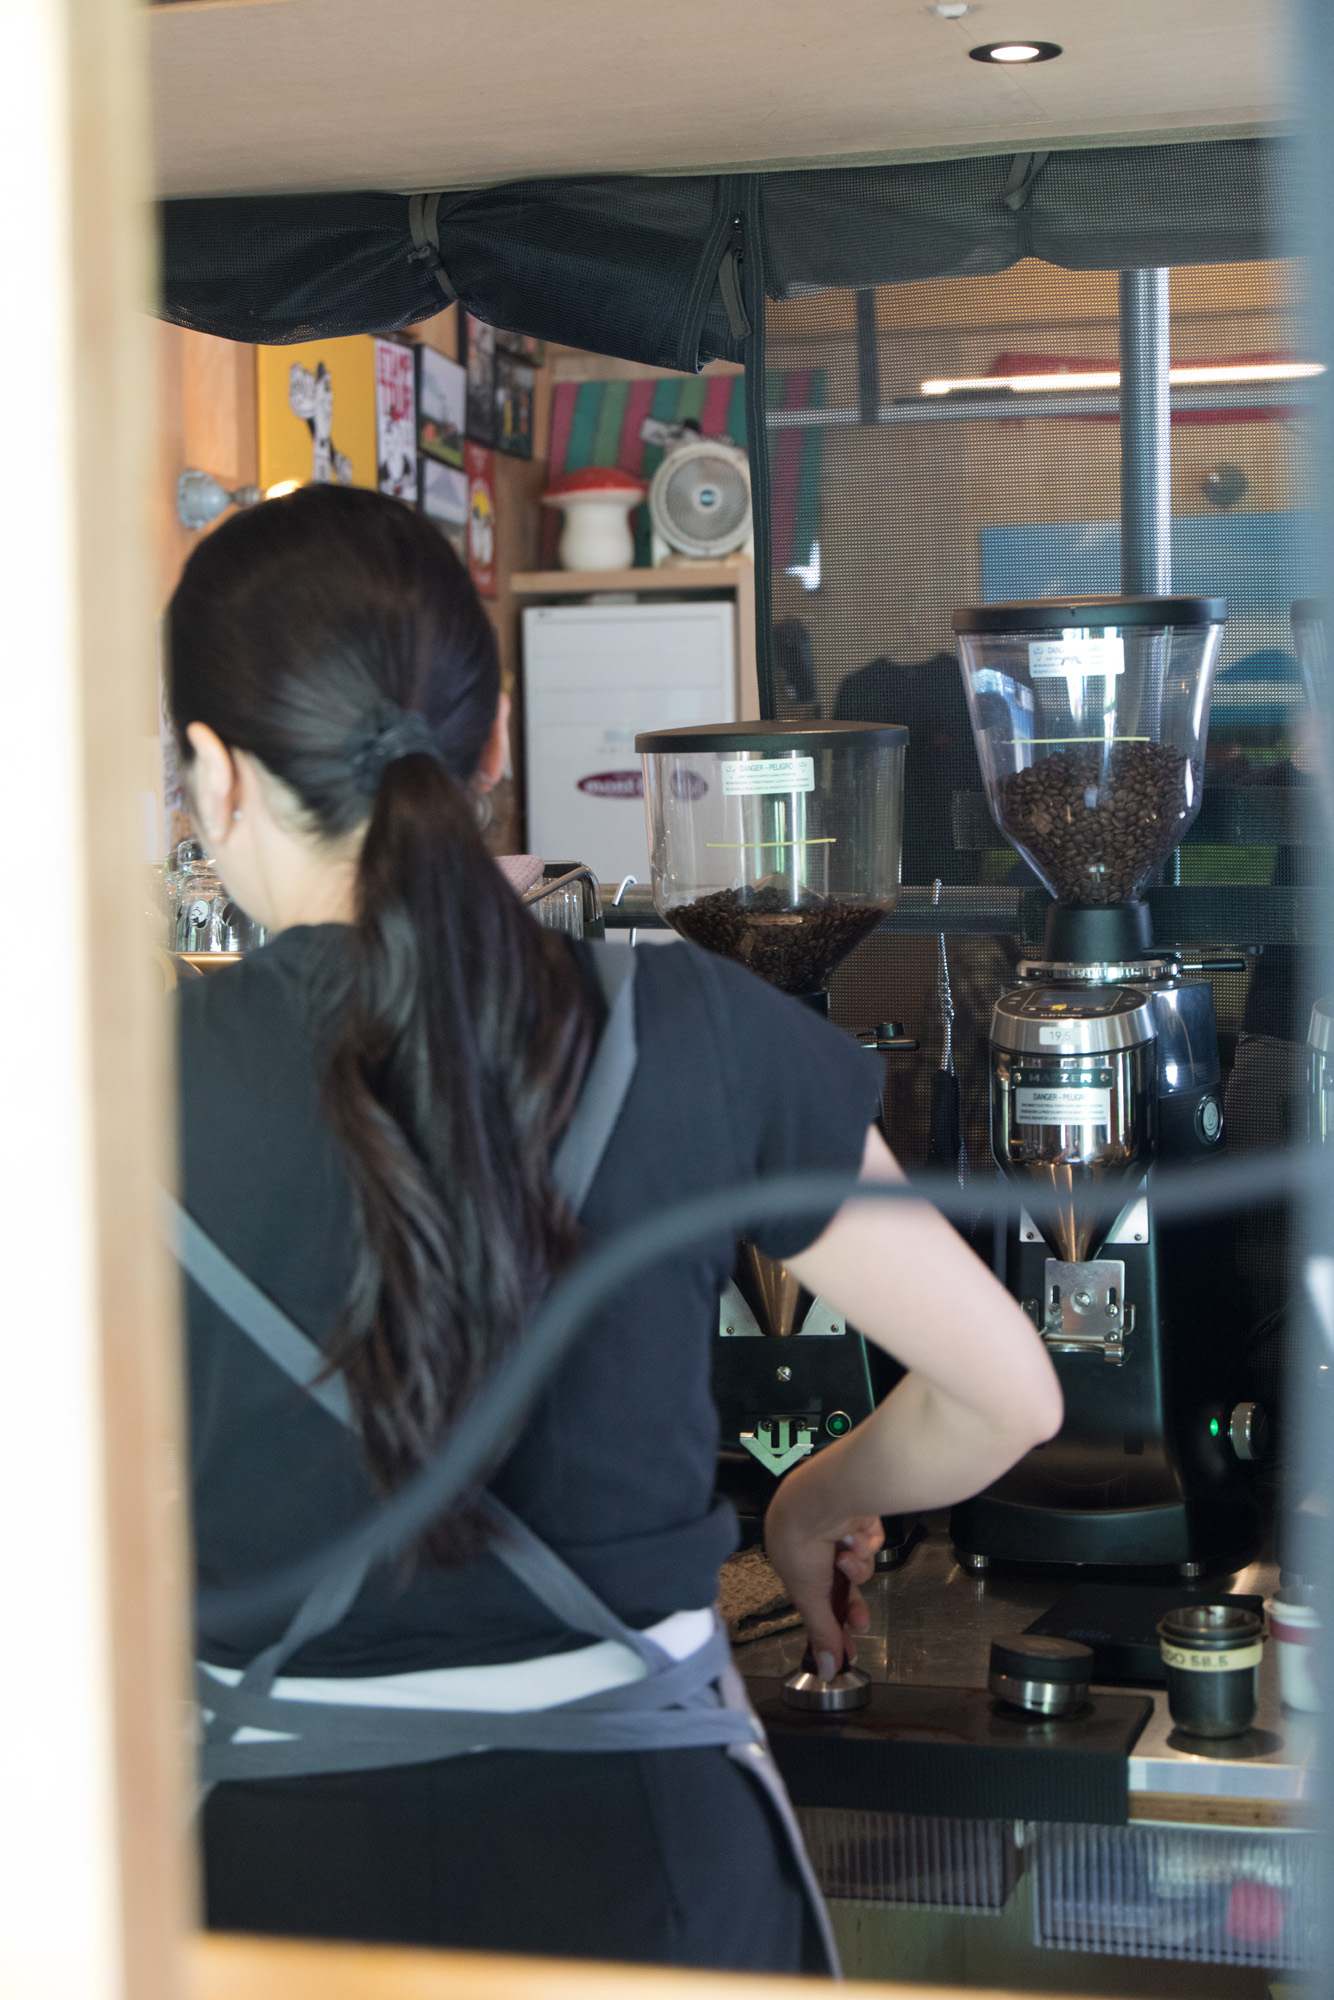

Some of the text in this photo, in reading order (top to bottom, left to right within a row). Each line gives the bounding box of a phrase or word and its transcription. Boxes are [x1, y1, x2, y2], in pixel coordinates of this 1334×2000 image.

[739, 763, 764, 773] DANGER
[768, 762, 794, 772] PELIGRO
[1049, 1031, 1071, 1042] 19.5
[1028, 1073, 1092, 1084] MAZZER
[1033, 1093, 1057, 1101] DANGER
